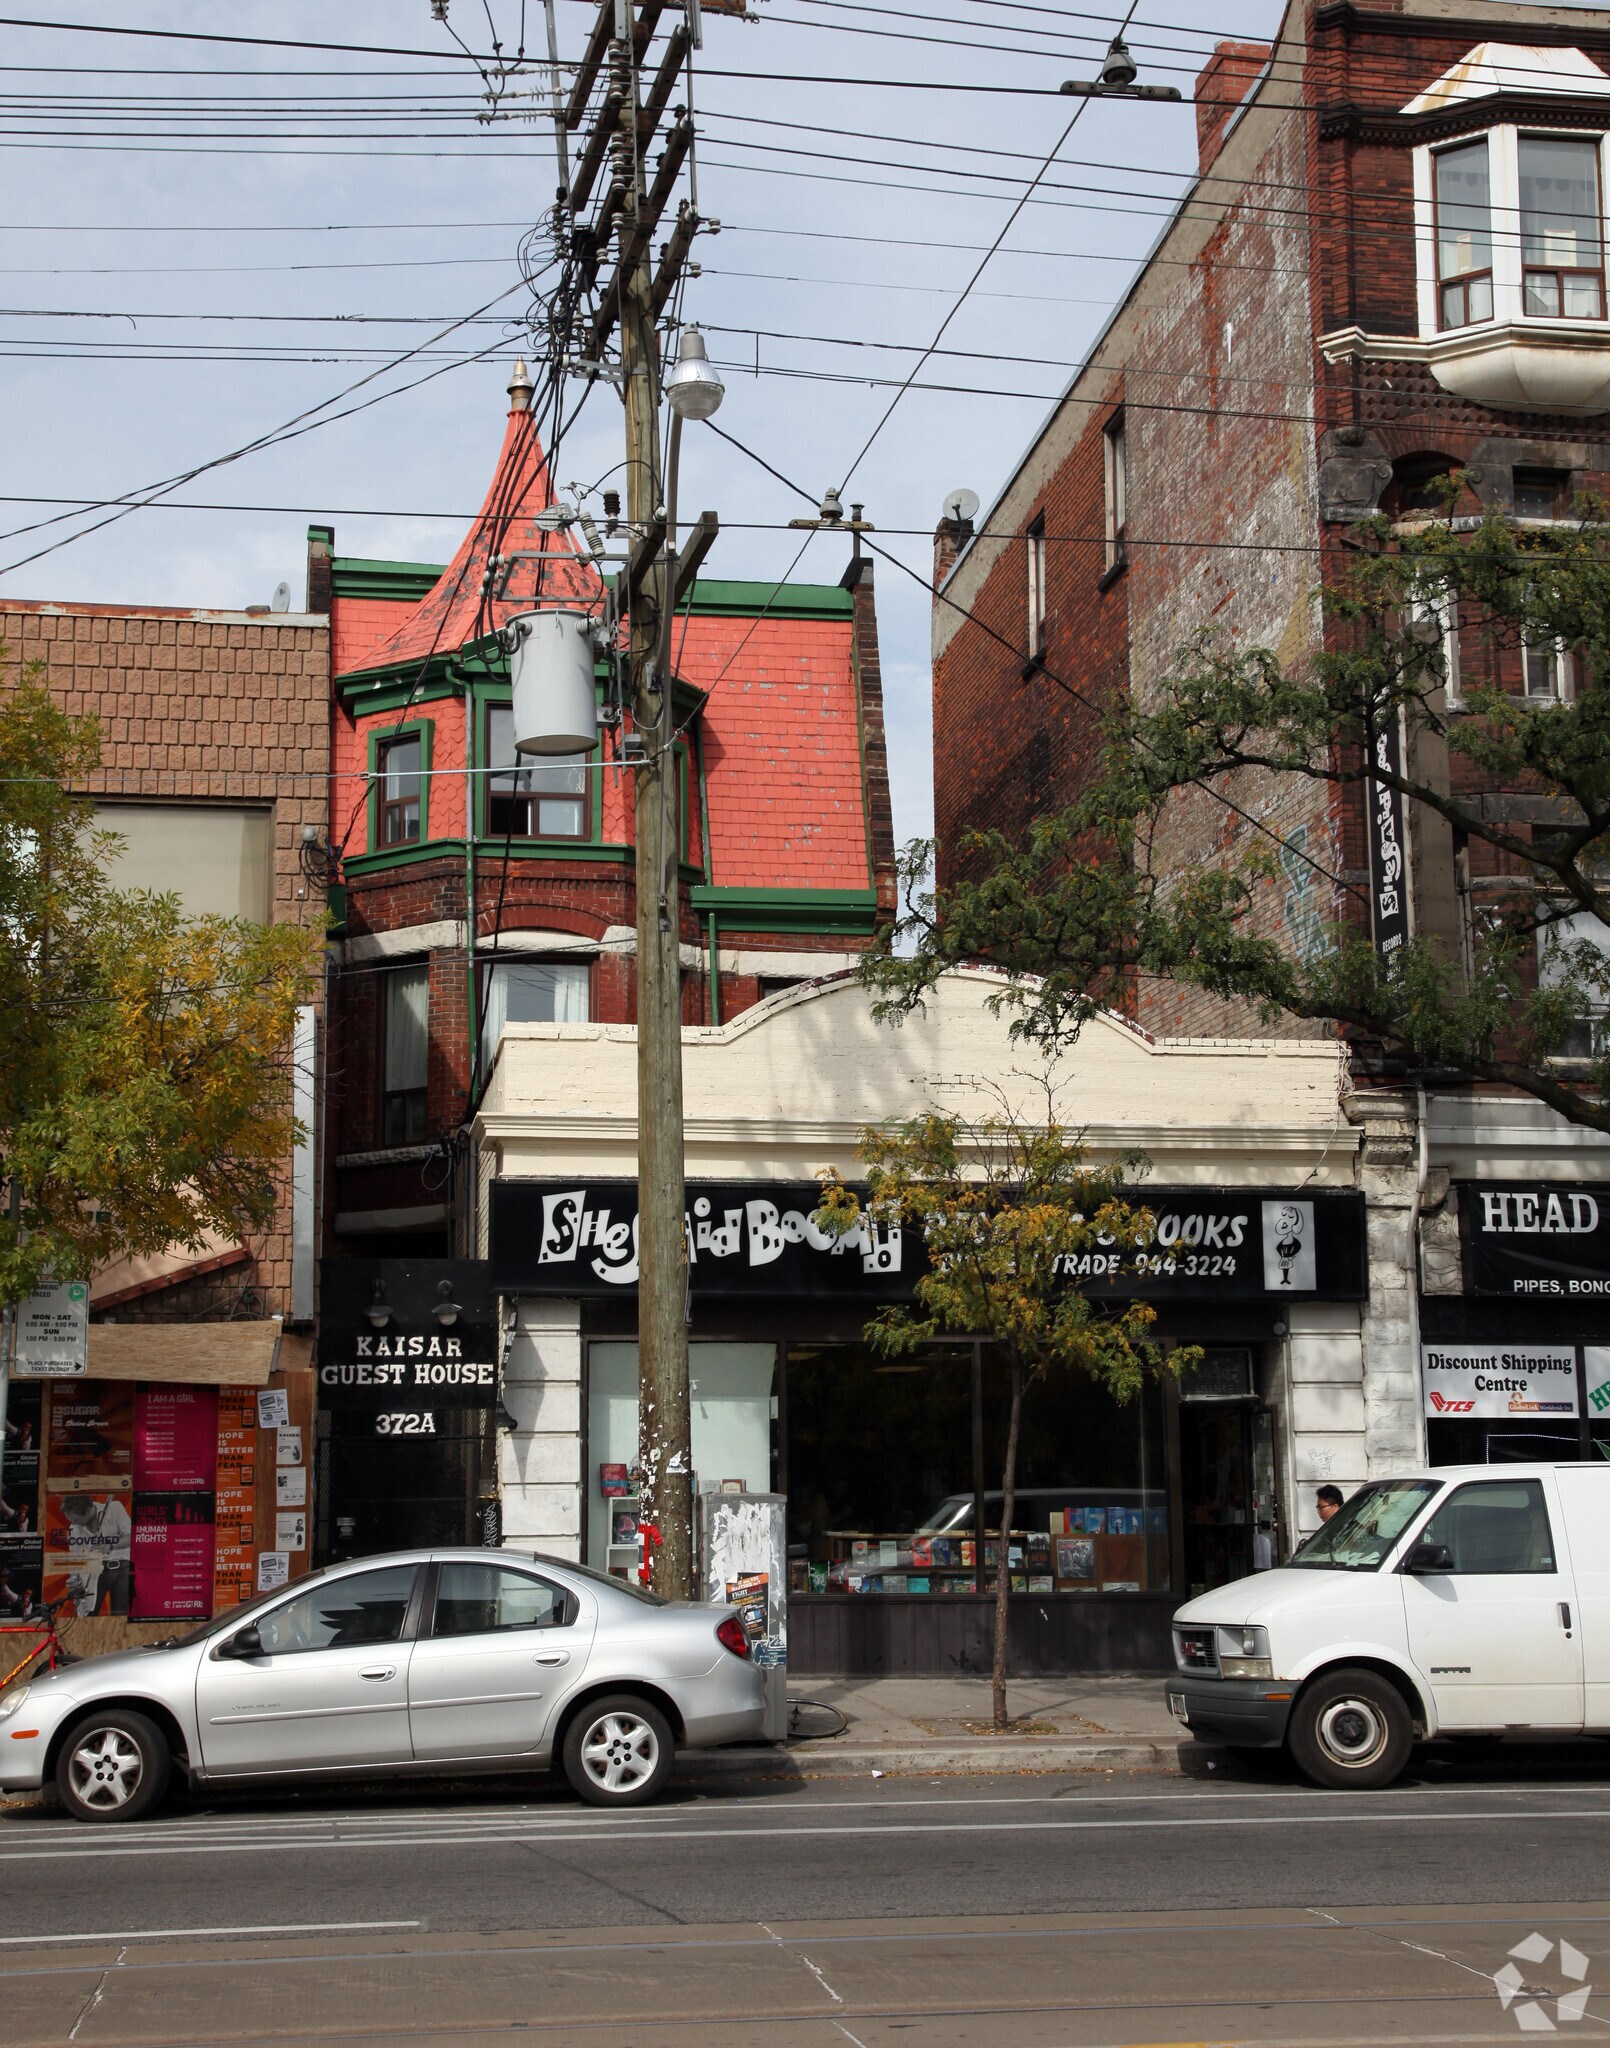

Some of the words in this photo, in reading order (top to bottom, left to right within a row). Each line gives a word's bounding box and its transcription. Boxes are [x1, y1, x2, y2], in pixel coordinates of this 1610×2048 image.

[1382, 933, 1402, 954] RECORDS
[1480, 1192, 1599, 1233] HEAD
[1051, 1253, 1121, 1275] TRADE
[1135, 1254, 1236, 1276] 944-3224
[1514, 1280, 1564, 1294] PIPES,
[357, 1337, 462, 1357] KAISAR
[1427, 1353, 1498, 1370] Discount
[1501, 1353, 1573, 1374] Shipping
[320, 1364, 405, 1385] GUEST
[415, 1363, 494, 1385] HOUSE
[1474, 1375, 1528, 1391] Centre
[153, 1395, 167, 1403] AM
[1444, 1400, 1477, 1412] TCS
[1509, 1402, 1539, 1411] GlobeLink
[63, 1406, 101, 1415] SUGAR
[375, 1413, 436, 1434] 372A
[50, 1529, 73, 1537] GET
[135, 1534, 167, 1543] RIGHTS
[50, 1536, 120, 1546] DISCOVERED
